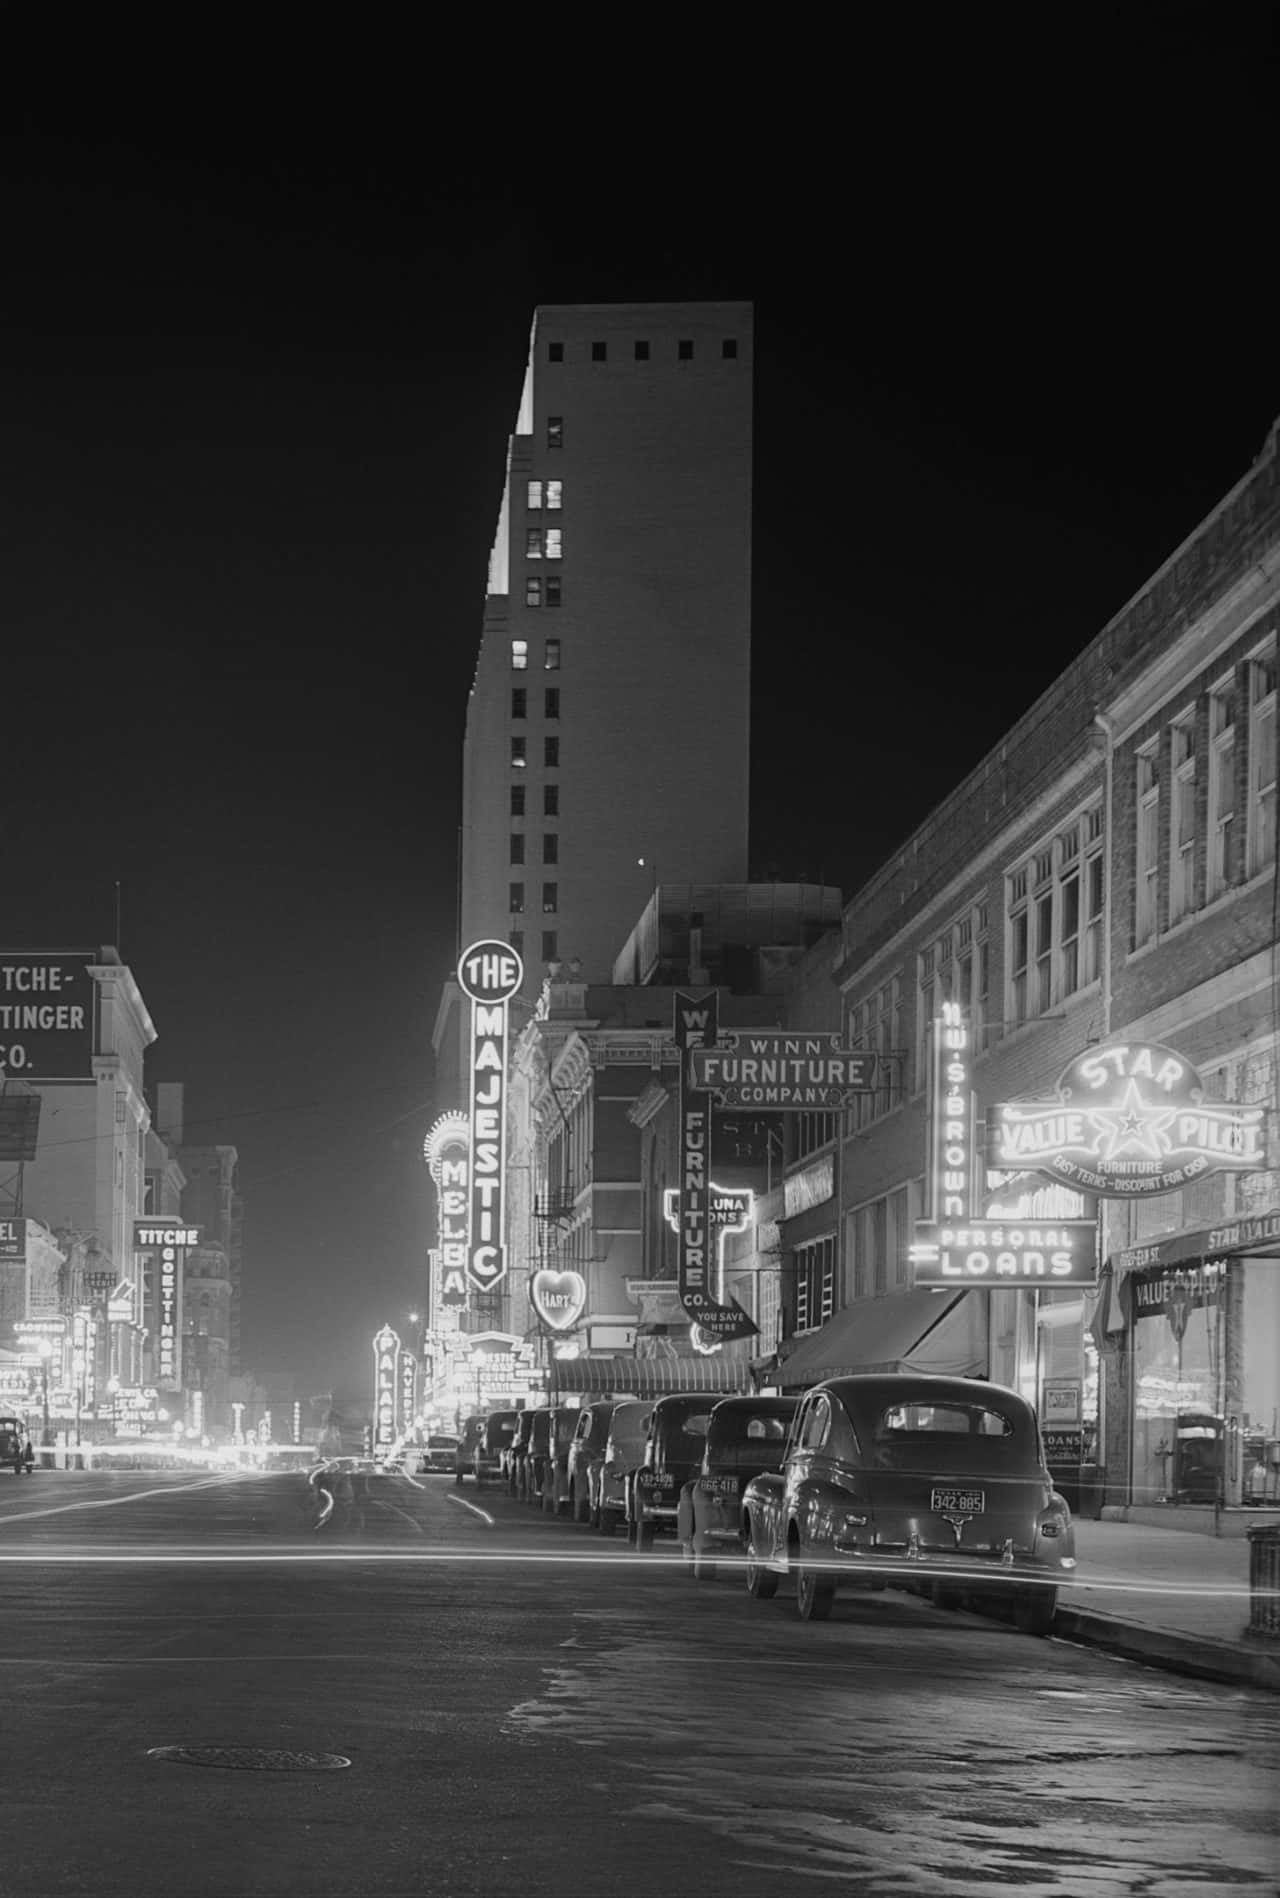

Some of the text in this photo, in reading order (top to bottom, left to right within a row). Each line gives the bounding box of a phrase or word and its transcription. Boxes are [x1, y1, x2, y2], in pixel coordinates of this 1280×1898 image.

[466, 954, 516, 990] THE
[750, 1038, 822, 1055] WINN
[704, 1058, 865, 1085] FURNITURE
[1080, 1046, 1184, 1090] STAR
[739, 1086, 830, 1103] COMPANY
[473, 1006, 505, 1277] MAJESTIC
[1001, 1114, 1260, 1154] VALUE PILOT
[944, 1096, 966, 1217] BROWN
[1097, 1160, 1164, 1174] FURNITURE
[1052, 1155, 1077, 1176] EASY
[1162, 1169, 1185, 1187] FOR
[684, 1111, 705, 1287] FURNITURE
[137, 1229, 200, 1245] TITCHE
[442, 1160, 468, 1294] MELBA
[940, 1229, 1073, 1248] PERSONAL
[941, 1251, 1073, 1276] LOANS
[683, 1294, 708, 1306] CO.
[698, 1312, 744, 1322] YOU SAVE
[711, 1323, 736, 1332] HERE
[379, 1336, 394, 1443] PALACE
[1047, 1436, 1081, 1446] OANS
